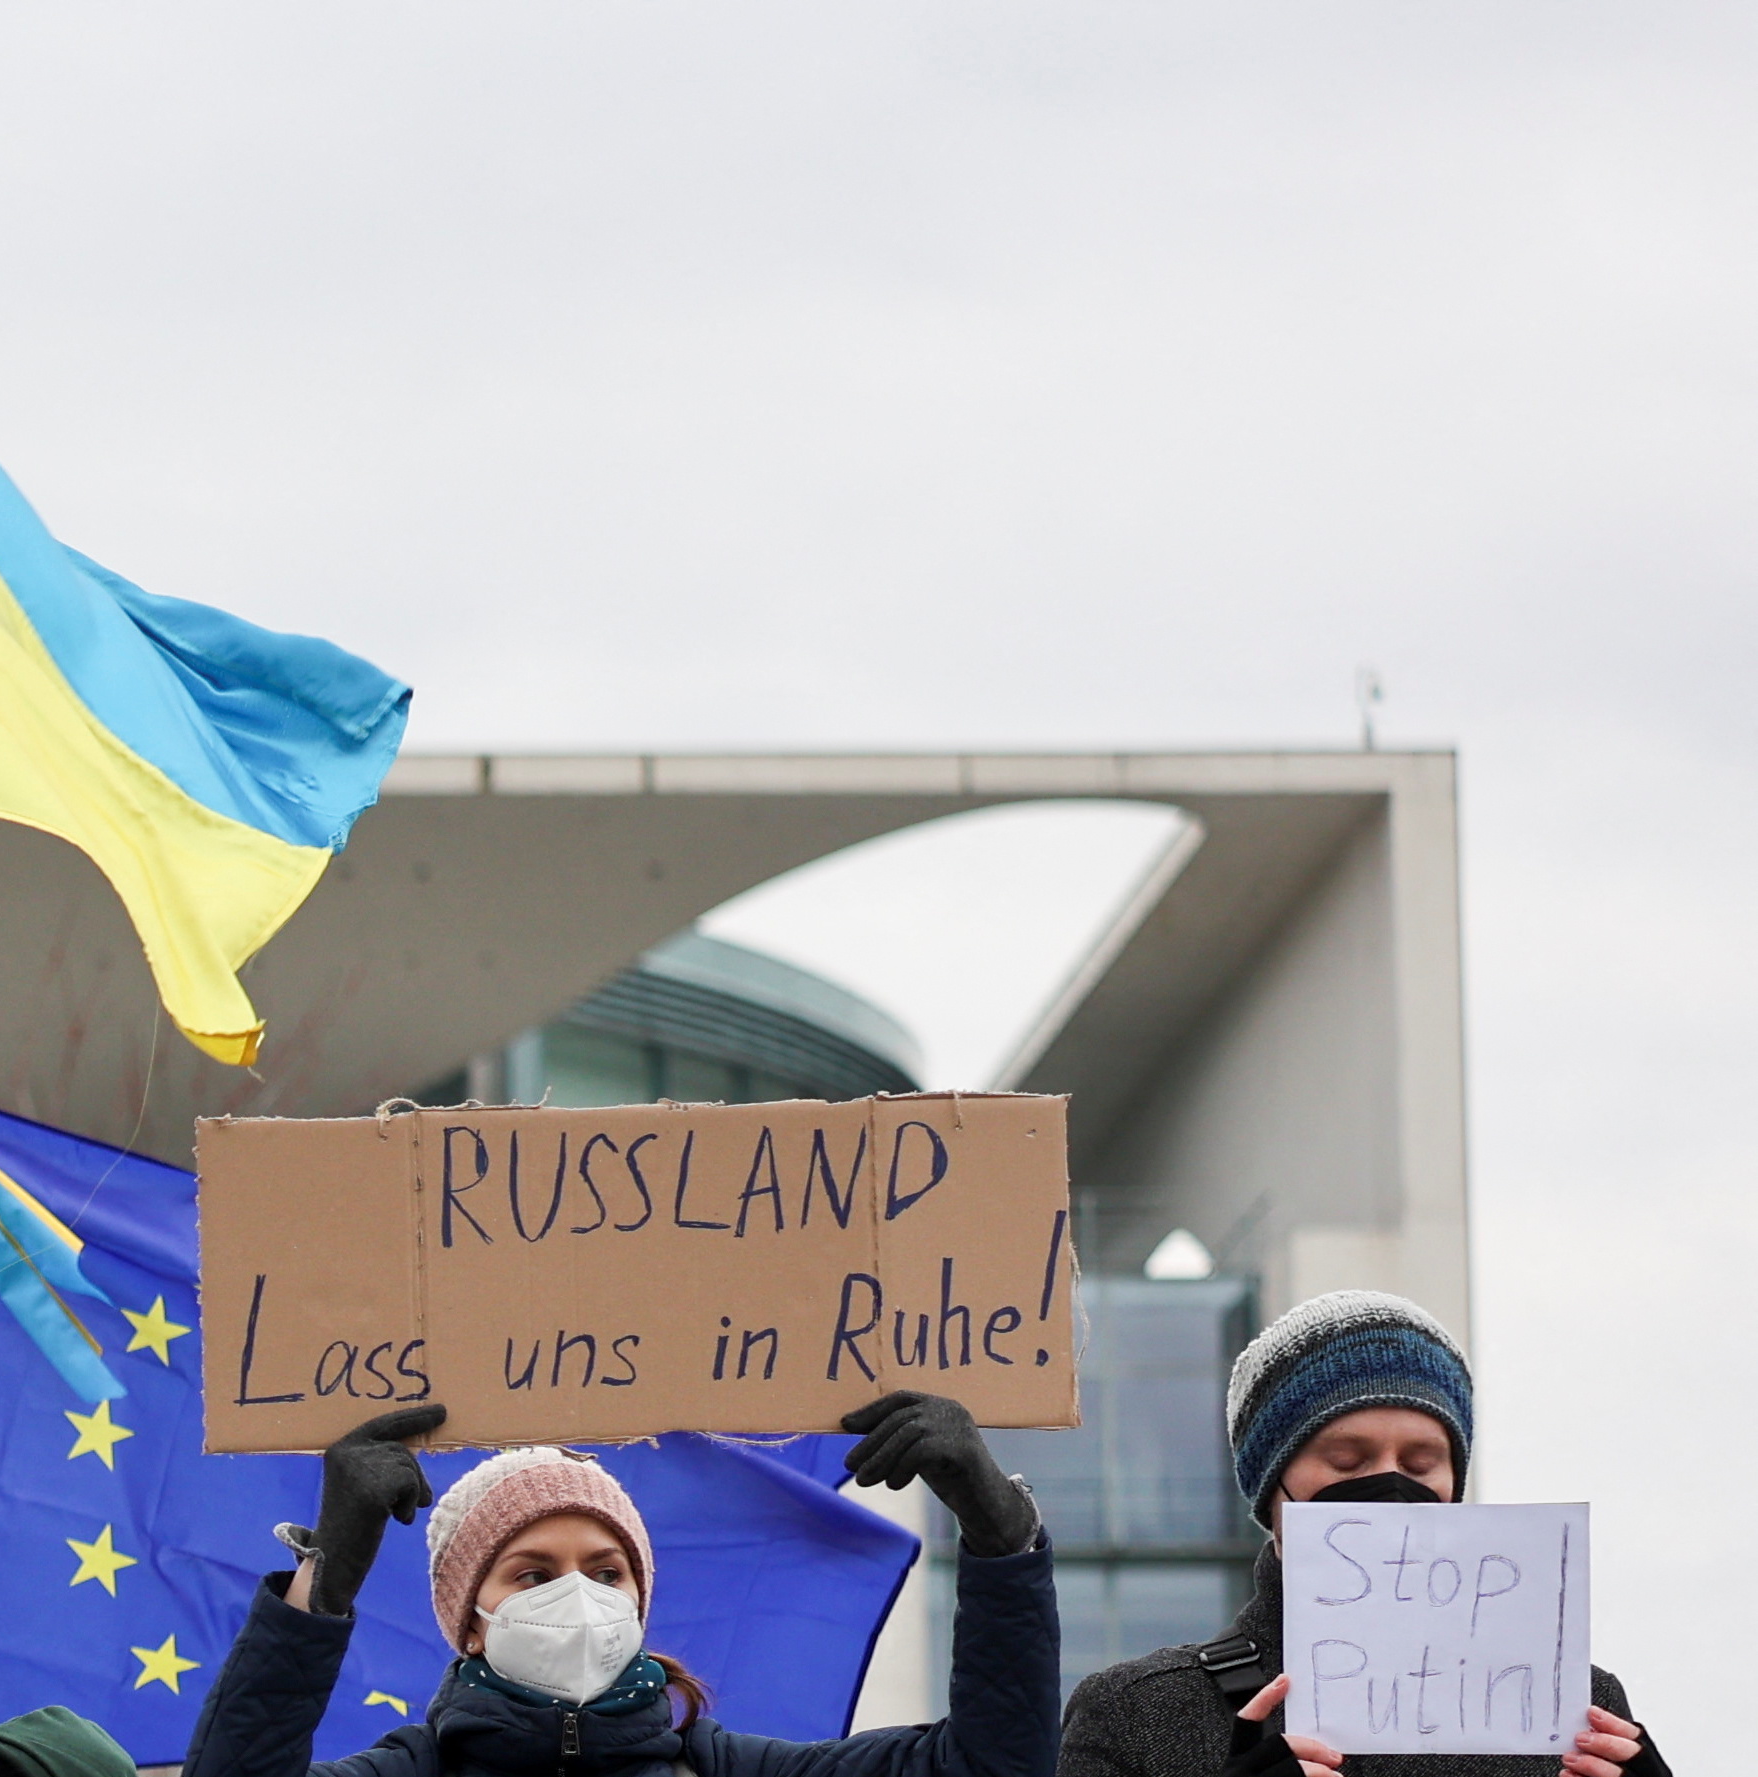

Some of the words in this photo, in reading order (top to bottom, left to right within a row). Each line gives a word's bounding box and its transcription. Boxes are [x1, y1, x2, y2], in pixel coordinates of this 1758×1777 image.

[441, 1121, 948, 1248] RUSSLAND
[233, 1274, 431, 1404] Lass
[504, 1328, 641, 1391] uns
[712, 1317, 777, 1380] in
[827, 1209, 1067, 1382] Ruhe!
[1314, 1518, 1520, 1637] Stop
